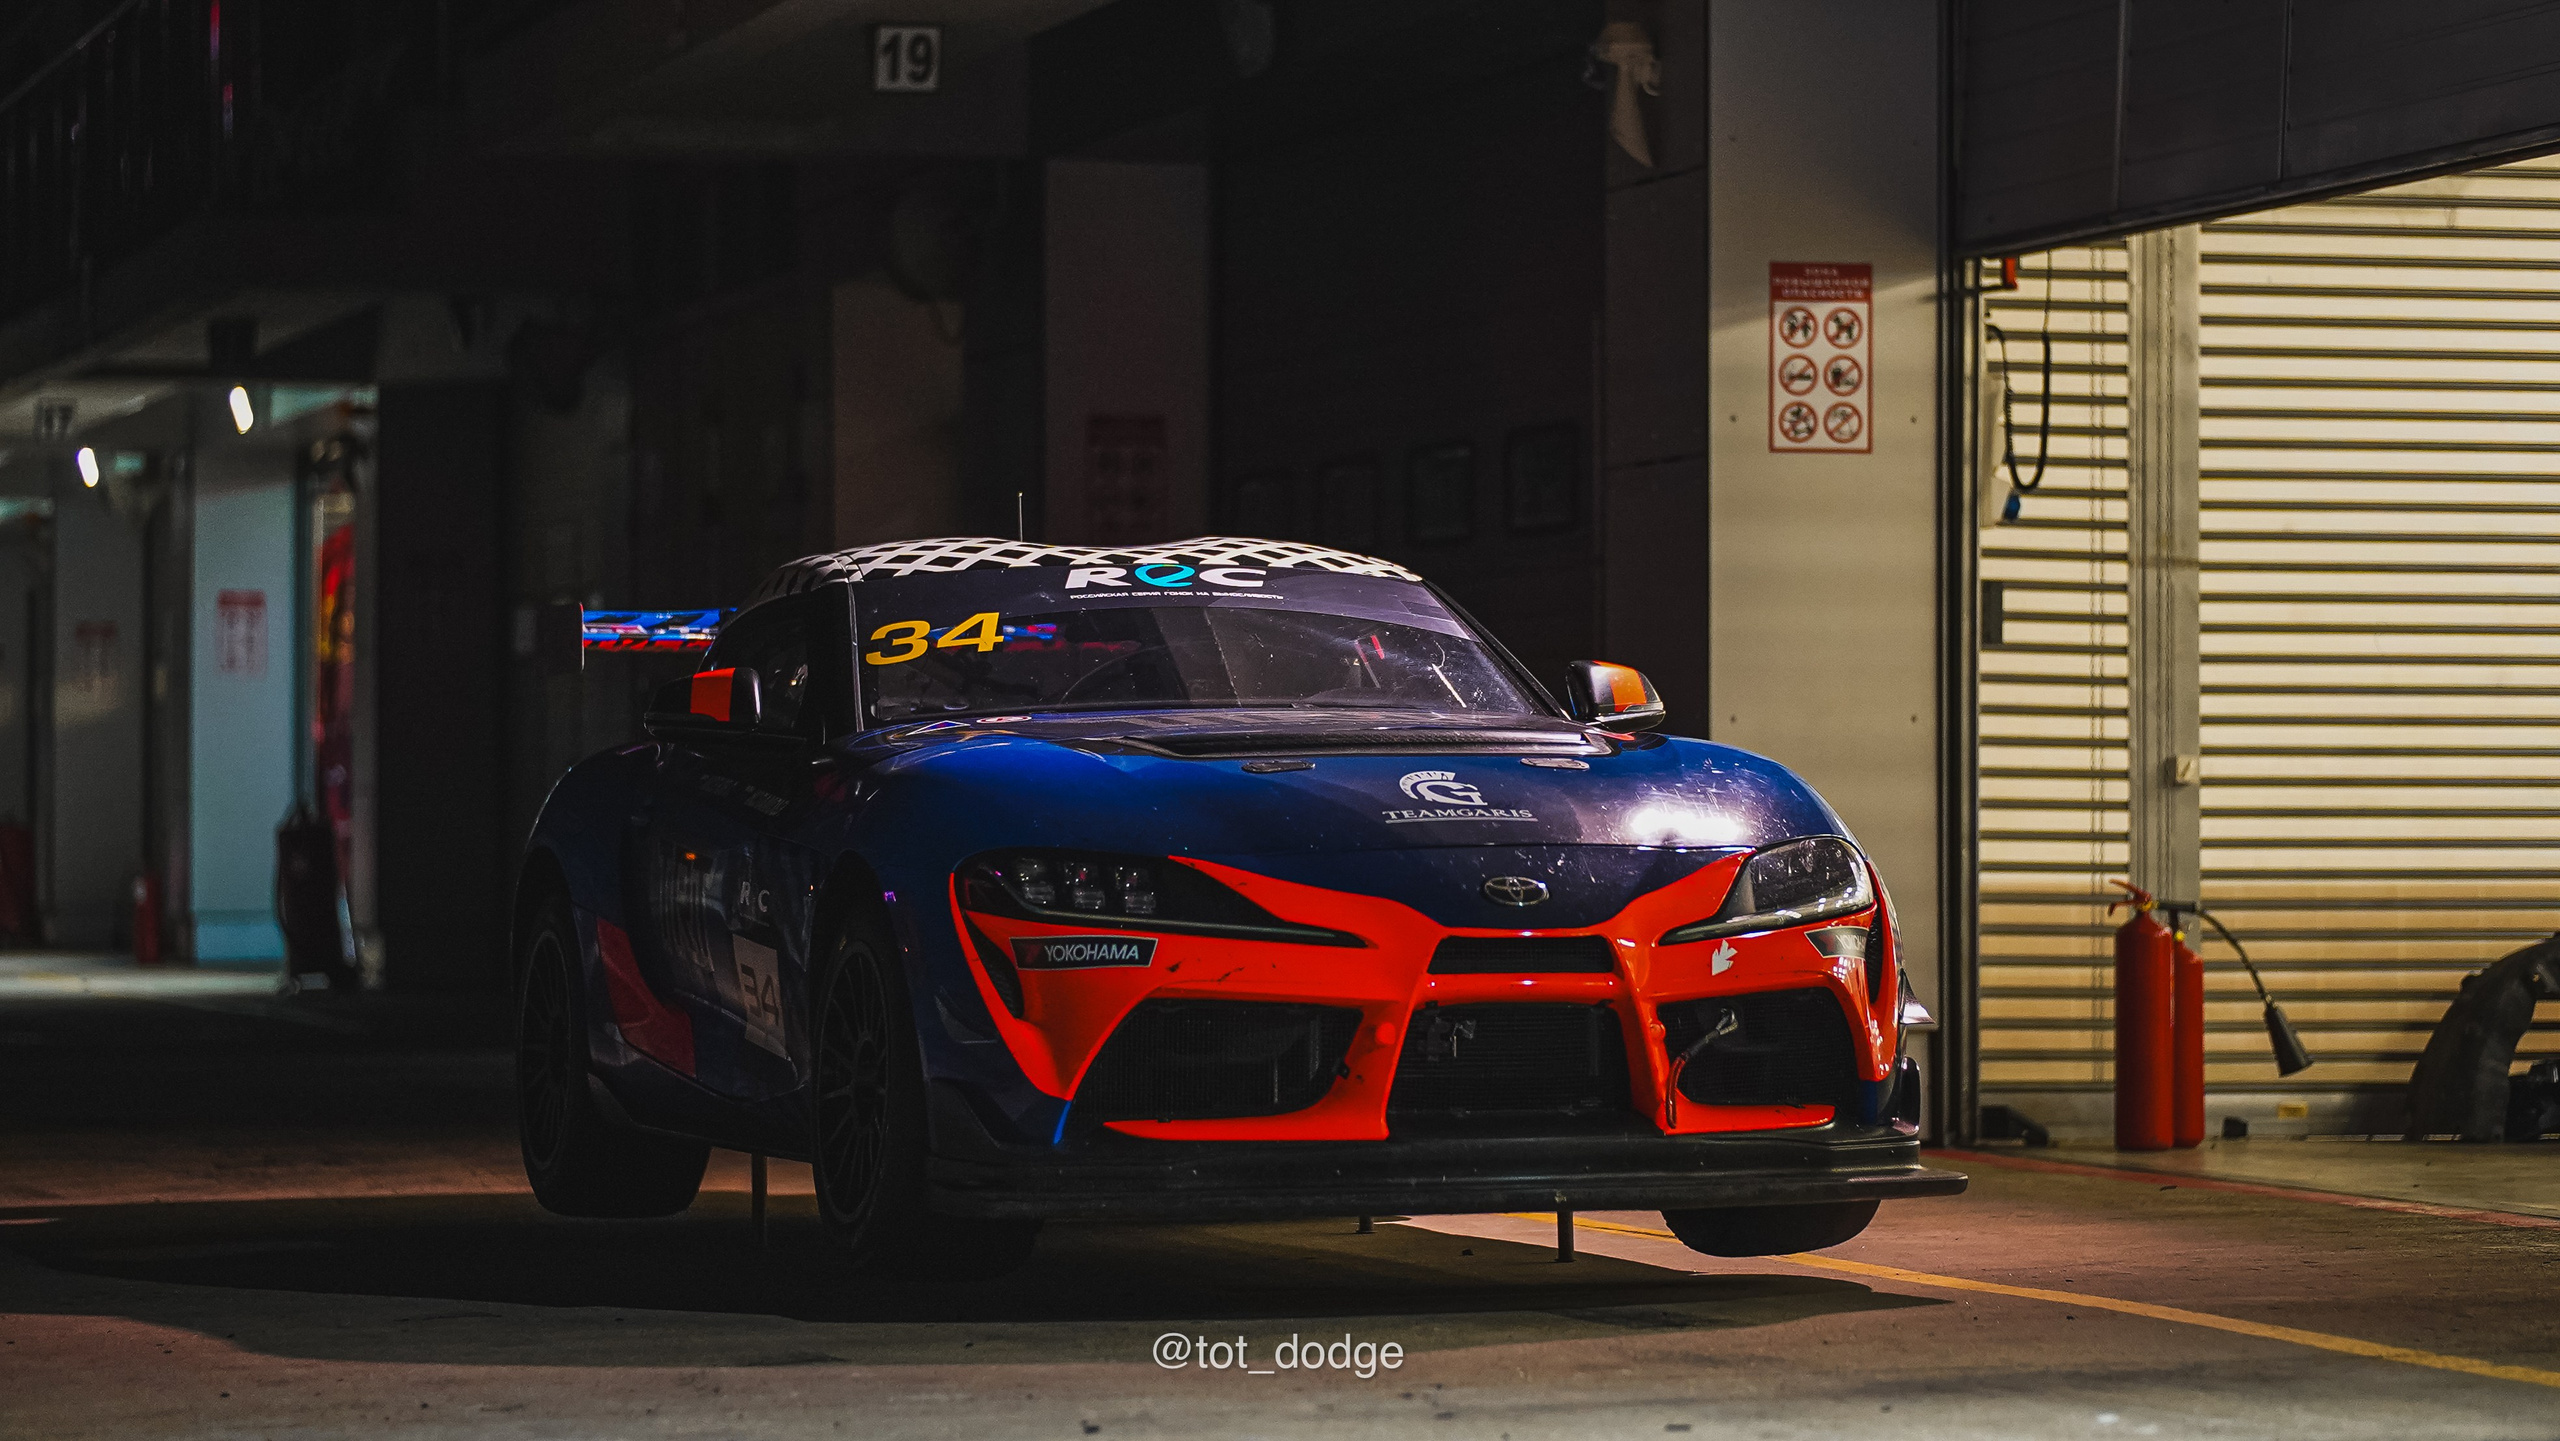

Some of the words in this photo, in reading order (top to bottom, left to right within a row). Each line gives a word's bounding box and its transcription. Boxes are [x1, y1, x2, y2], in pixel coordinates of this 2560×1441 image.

[883, 32, 933, 82] 19
[865, 612, 1005, 666] 34
[1382, 808, 1533, 820] TEAMGARIS
[1044, 943, 1140, 962] YOKOHAMA
[740, 963, 780, 1027] 34
